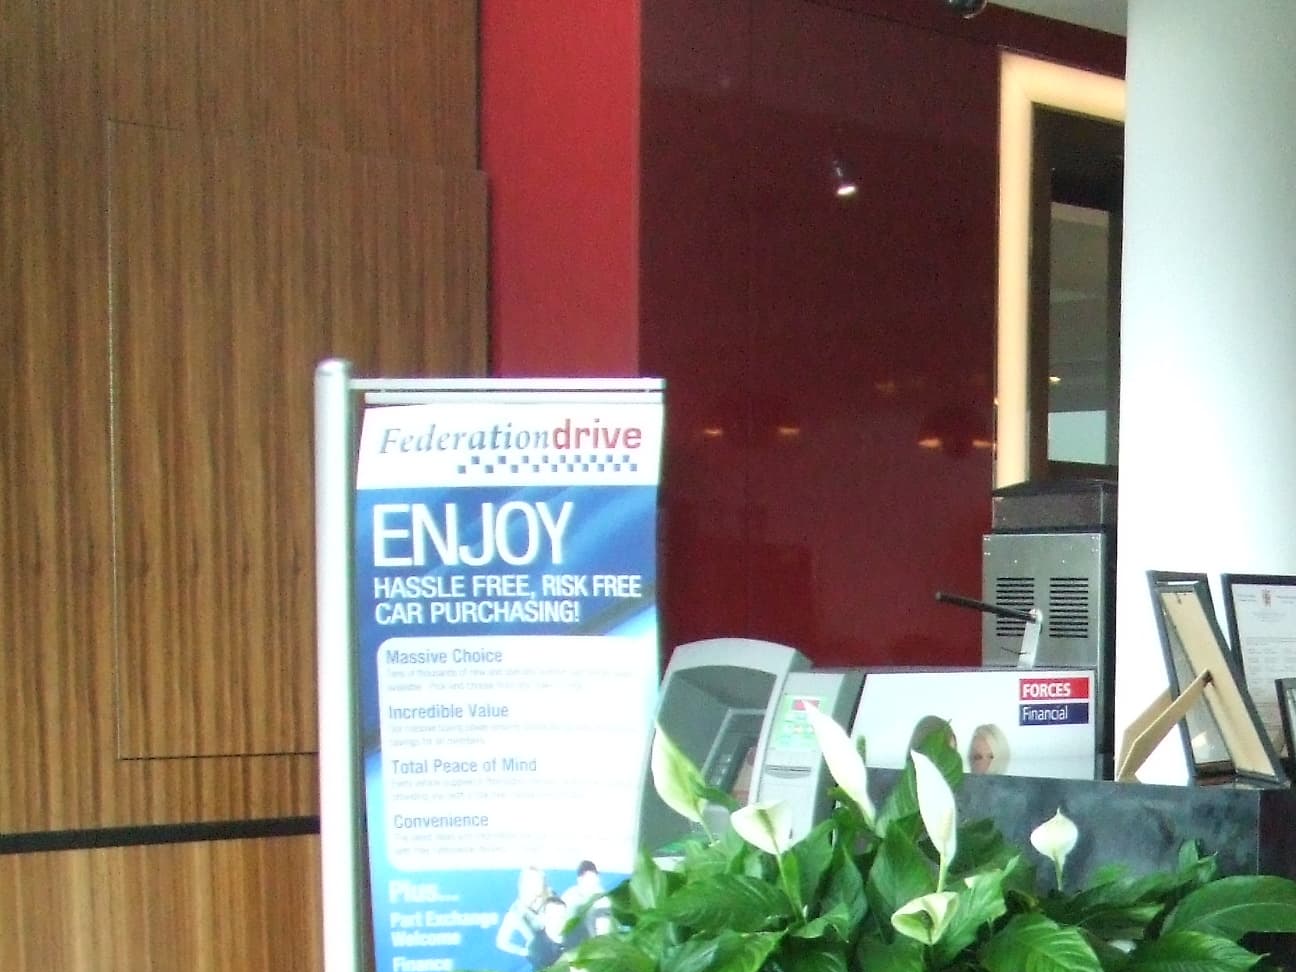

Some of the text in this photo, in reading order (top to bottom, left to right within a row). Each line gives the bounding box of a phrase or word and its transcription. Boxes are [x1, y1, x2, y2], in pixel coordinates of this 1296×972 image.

[378, 418, 642, 454] Federationdrive
[373, 501, 573, 567] ENJOY
[374, 575, 642, 600] HASSLE FREE, RISK FREE
[375, 600, 580, 625] CAR PURCHASING!
[386, 648, 503, 664] Massive Choice
[1022, 682, 1071, 698] FORCES
[389, 703, 509, 720] Incredible Value
[1022, 704, 1068, 721] Financial
[391, 757, 537, 774] Total Peace of Mind
[393, 814, 489, 829] Convenience
[425, 911, 500, 929] Exchange
[391, 930, 462, 948] Welcome
